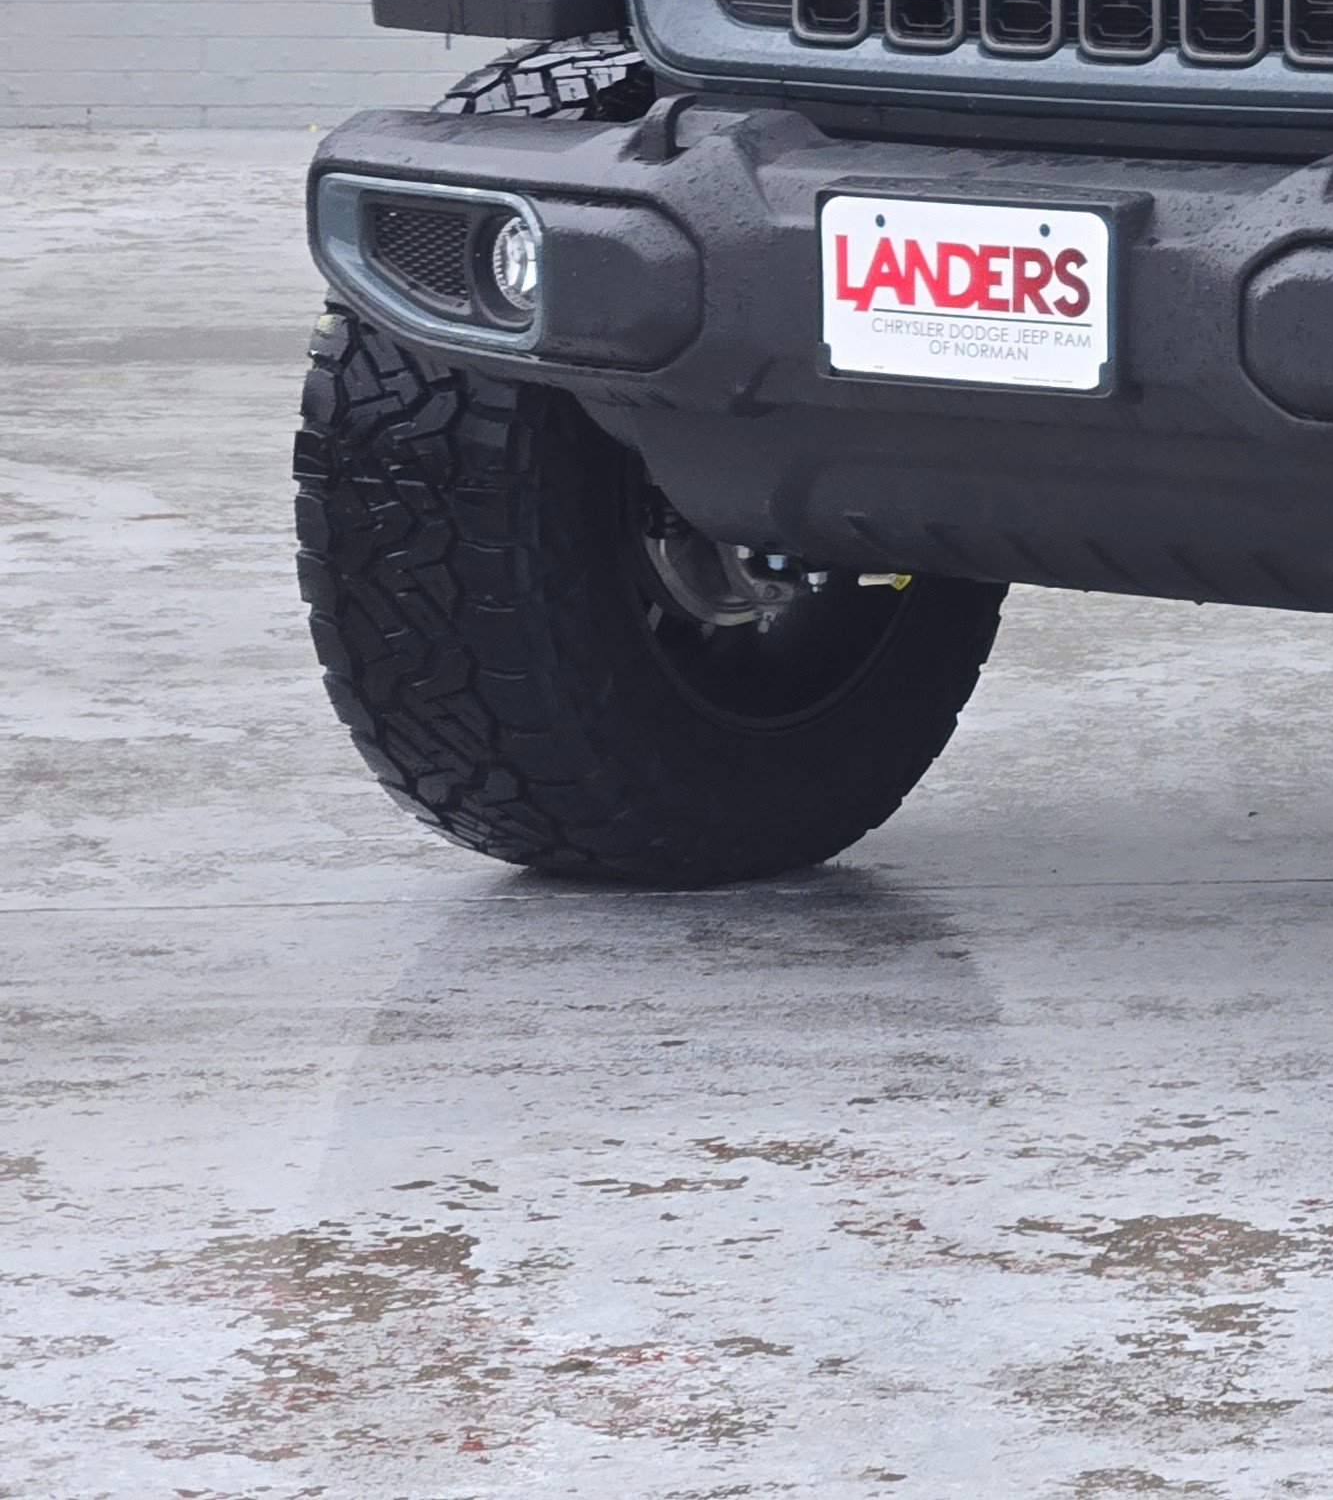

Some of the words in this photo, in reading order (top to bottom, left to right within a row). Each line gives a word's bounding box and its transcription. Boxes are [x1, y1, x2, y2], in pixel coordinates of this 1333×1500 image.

[835, 234, 1091, 319] LANDERS
[871, 317, 945, 339] CHRYSLER
[949, 324, 1010, 343] DODGE
[1013, 328, 1050, 345] JEEP
[1053, 331, 1092, 349] RAM
[929, 340, 951, 355] OF
[954, 342, 1029, 361] NORMAN
